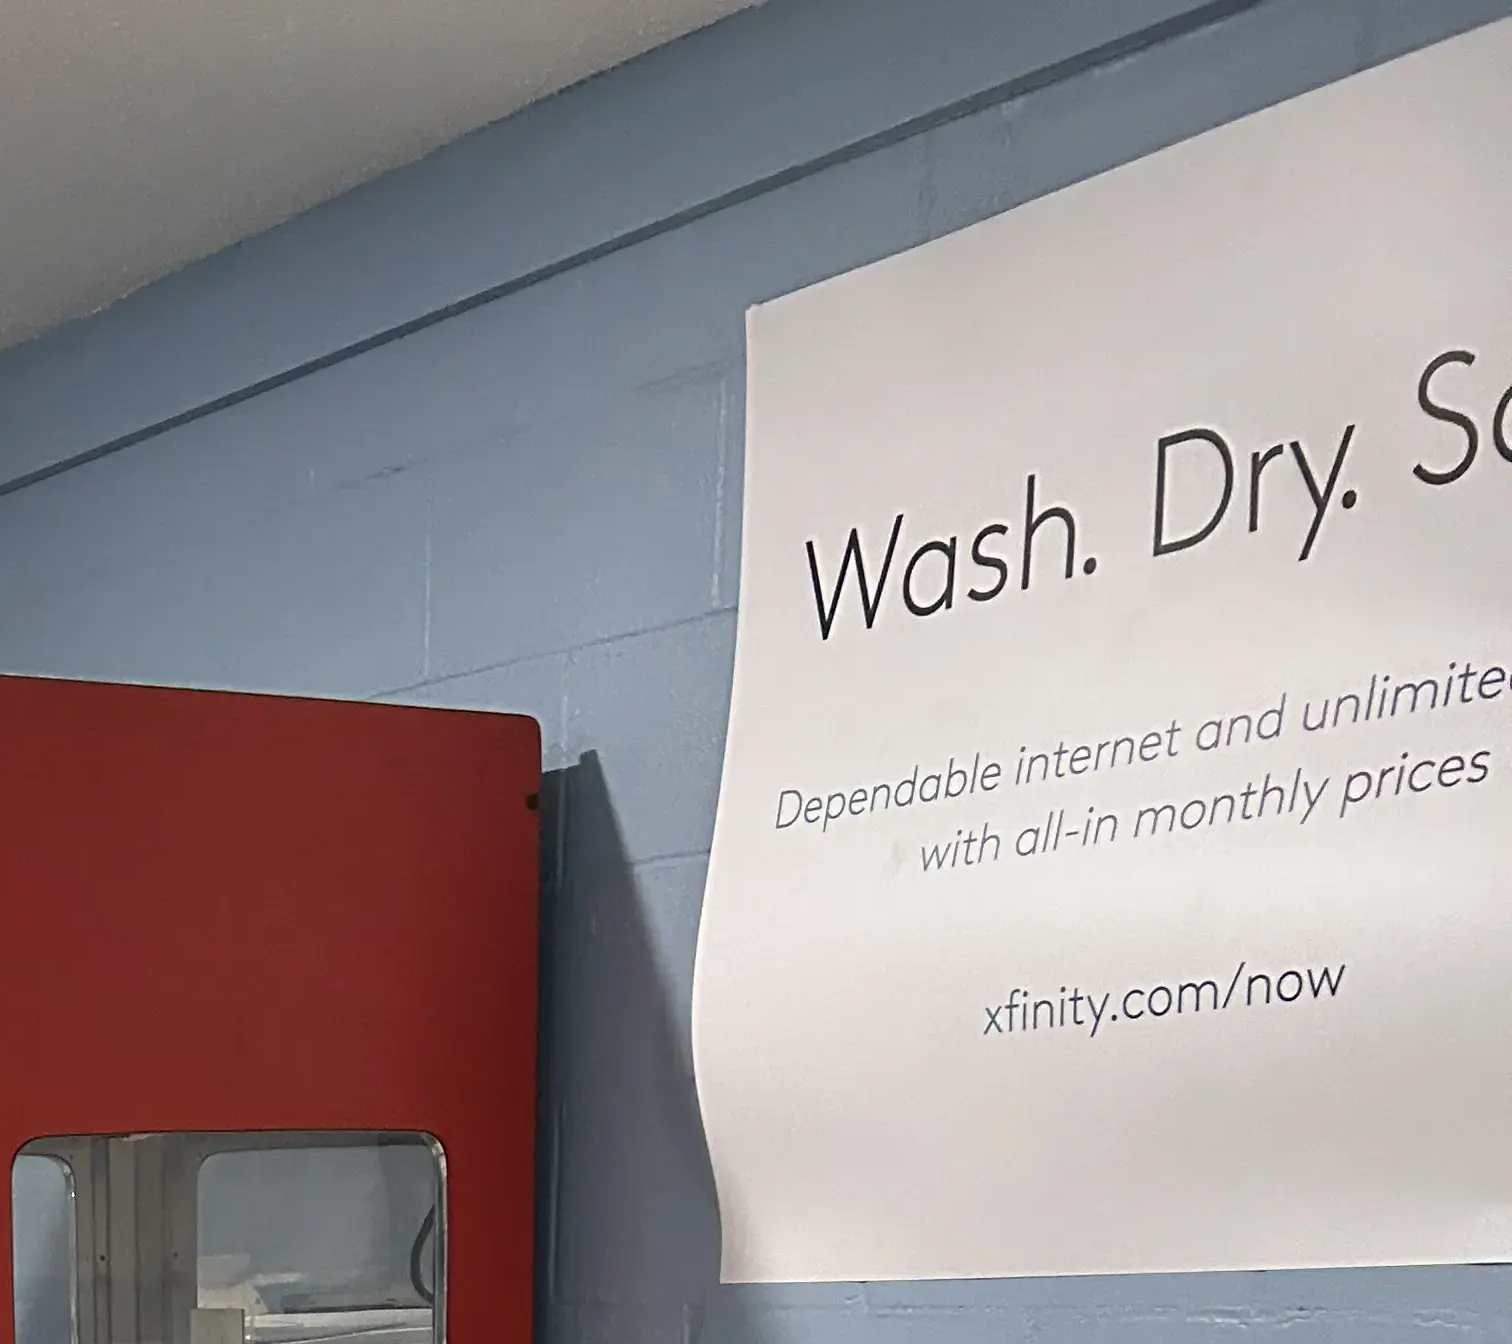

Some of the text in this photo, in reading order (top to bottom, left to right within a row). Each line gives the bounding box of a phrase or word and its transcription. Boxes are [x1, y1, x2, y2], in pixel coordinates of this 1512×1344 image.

[805, 349, 1512, 642] Wash. Dry. S
[774, 661, 1512, 833] Dependable internet and unlimite
[919, 748, 1492, 872] with all-in monthly prices
[982, 960, 1347, 1038] xfinity.com/now
